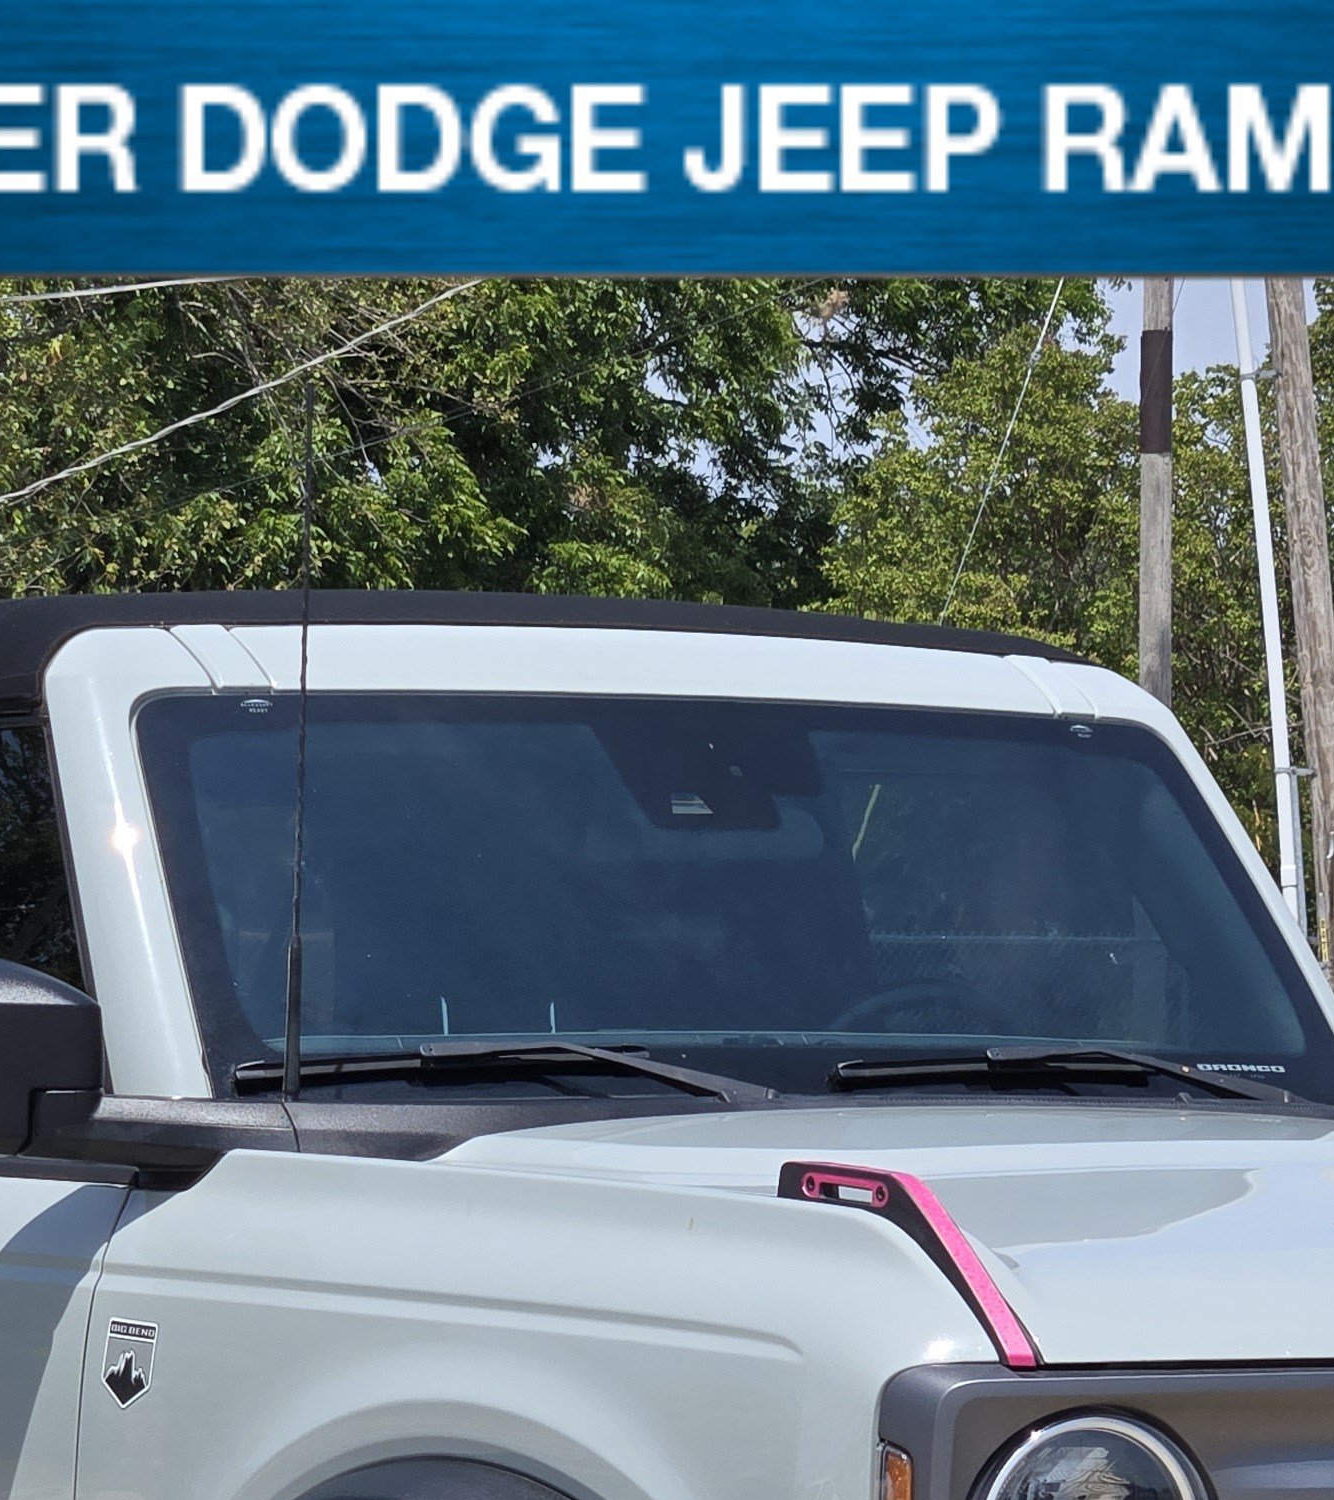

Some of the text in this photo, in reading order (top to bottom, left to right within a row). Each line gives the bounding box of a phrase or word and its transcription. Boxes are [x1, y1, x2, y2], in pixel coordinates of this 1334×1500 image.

[1196, 1063, 1286, 1073] BRONCO
[110, 1323, 156, 1338] BIG BEND
